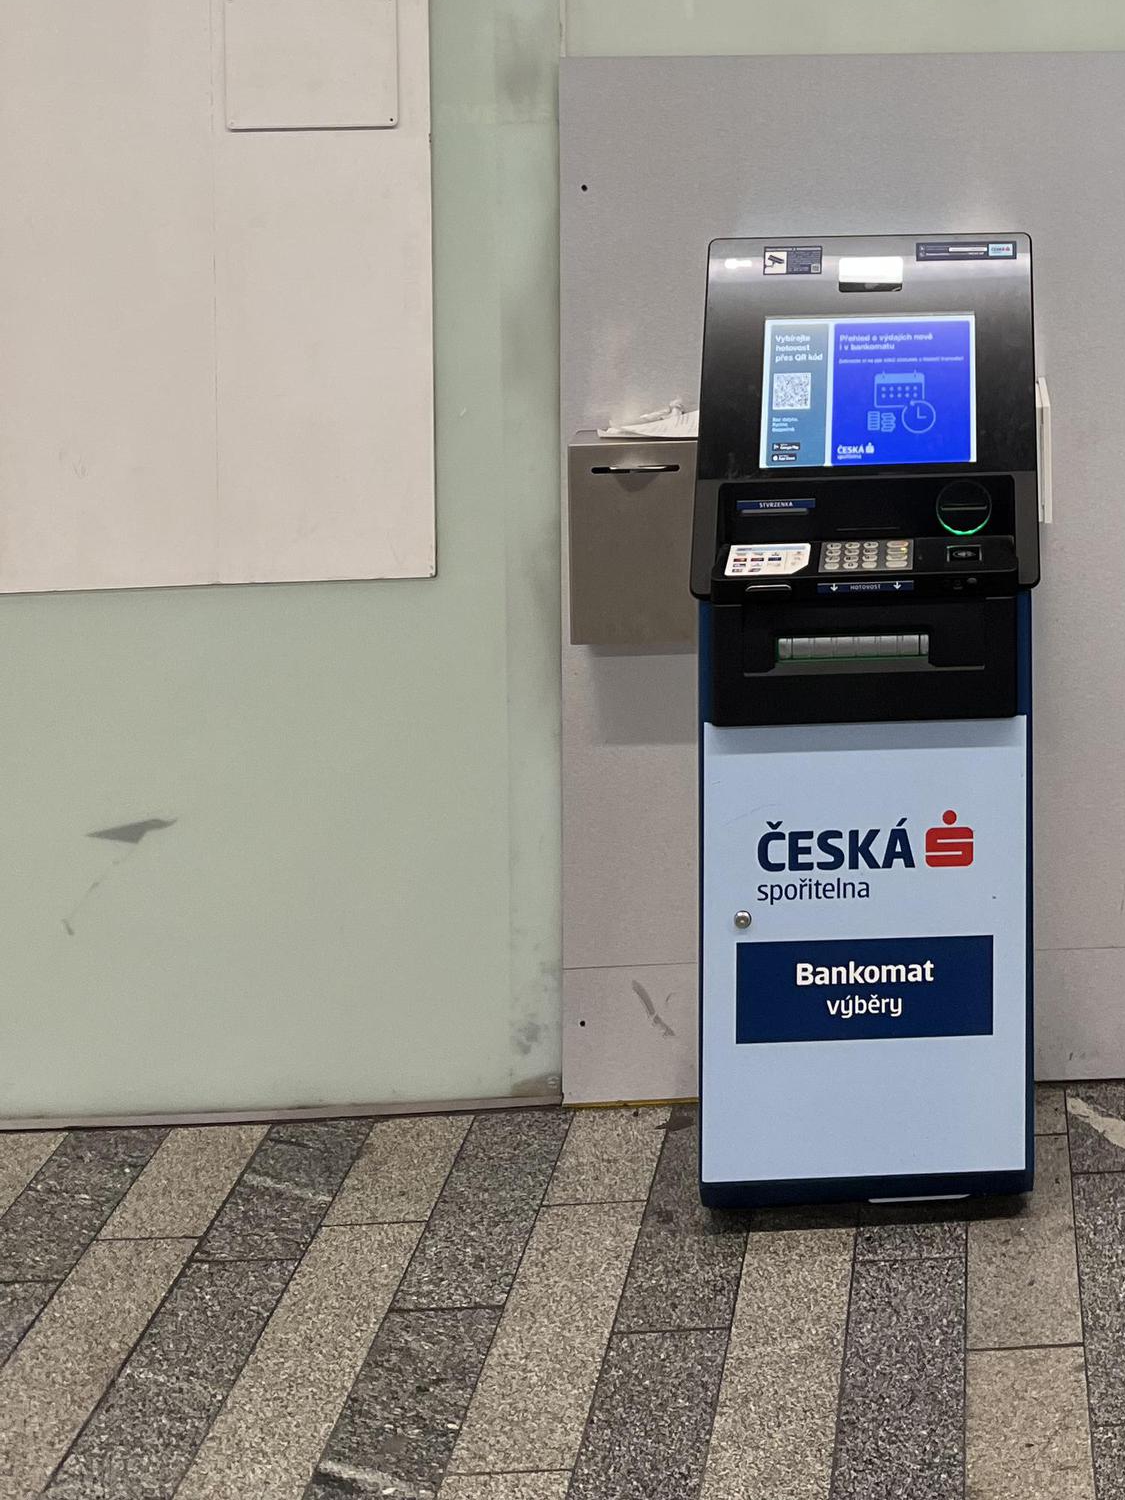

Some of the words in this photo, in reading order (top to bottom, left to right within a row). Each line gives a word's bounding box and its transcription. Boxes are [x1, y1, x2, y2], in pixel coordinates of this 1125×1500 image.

[795, 353, 807, 362] QR
[837, 444, 864, 454] ČESKÁ
[758, 501, 794, 509] STVRZENKA
[757, 817, 915, 872] ČESKÁ
[756, 877, 870, 904] spořitelna
[795, 960, 934, 986] Bankomat
[826, 994, 902, 1018] výběry
